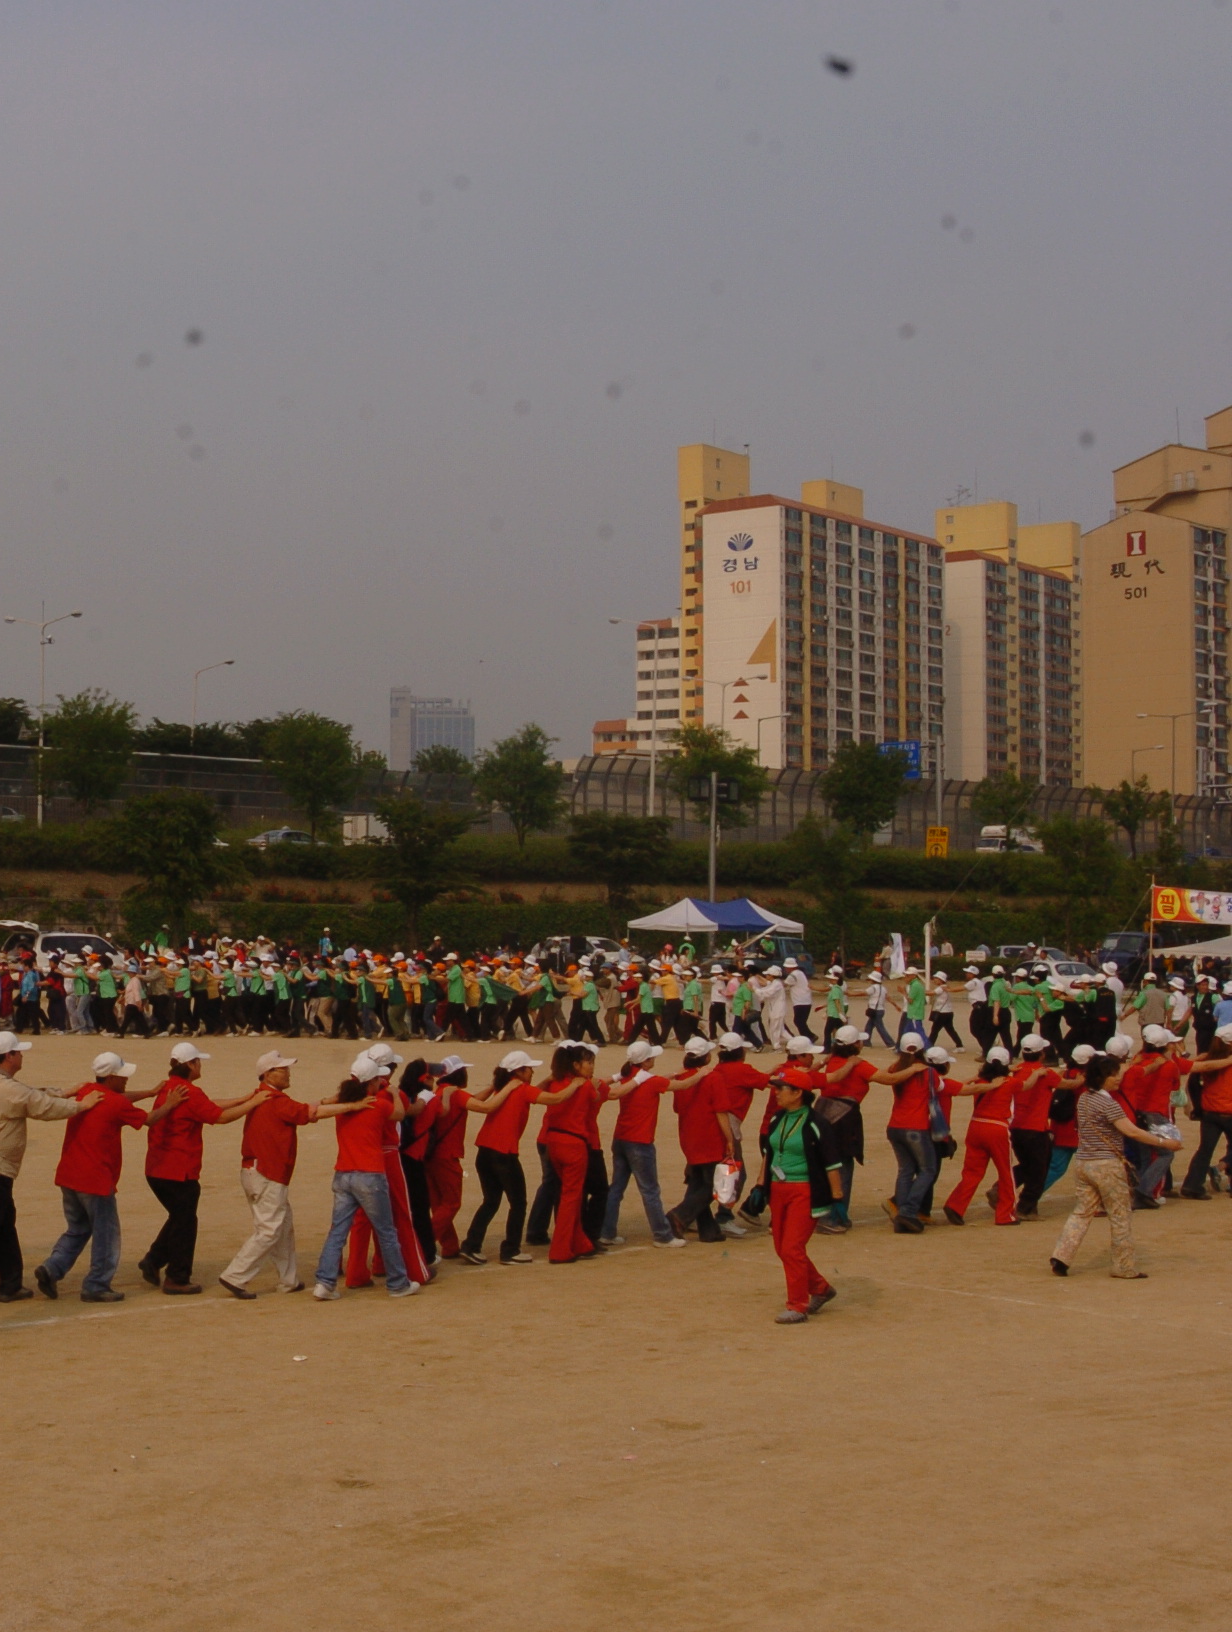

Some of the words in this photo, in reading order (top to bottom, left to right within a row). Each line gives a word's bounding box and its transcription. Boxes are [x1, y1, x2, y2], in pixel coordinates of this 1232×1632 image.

[722, 556, 759, 573] 경남
[730, 580, 751, 593] 101
[1124, 587, 1147, 600] 501
[1159, 894, 1175, 915] 필
